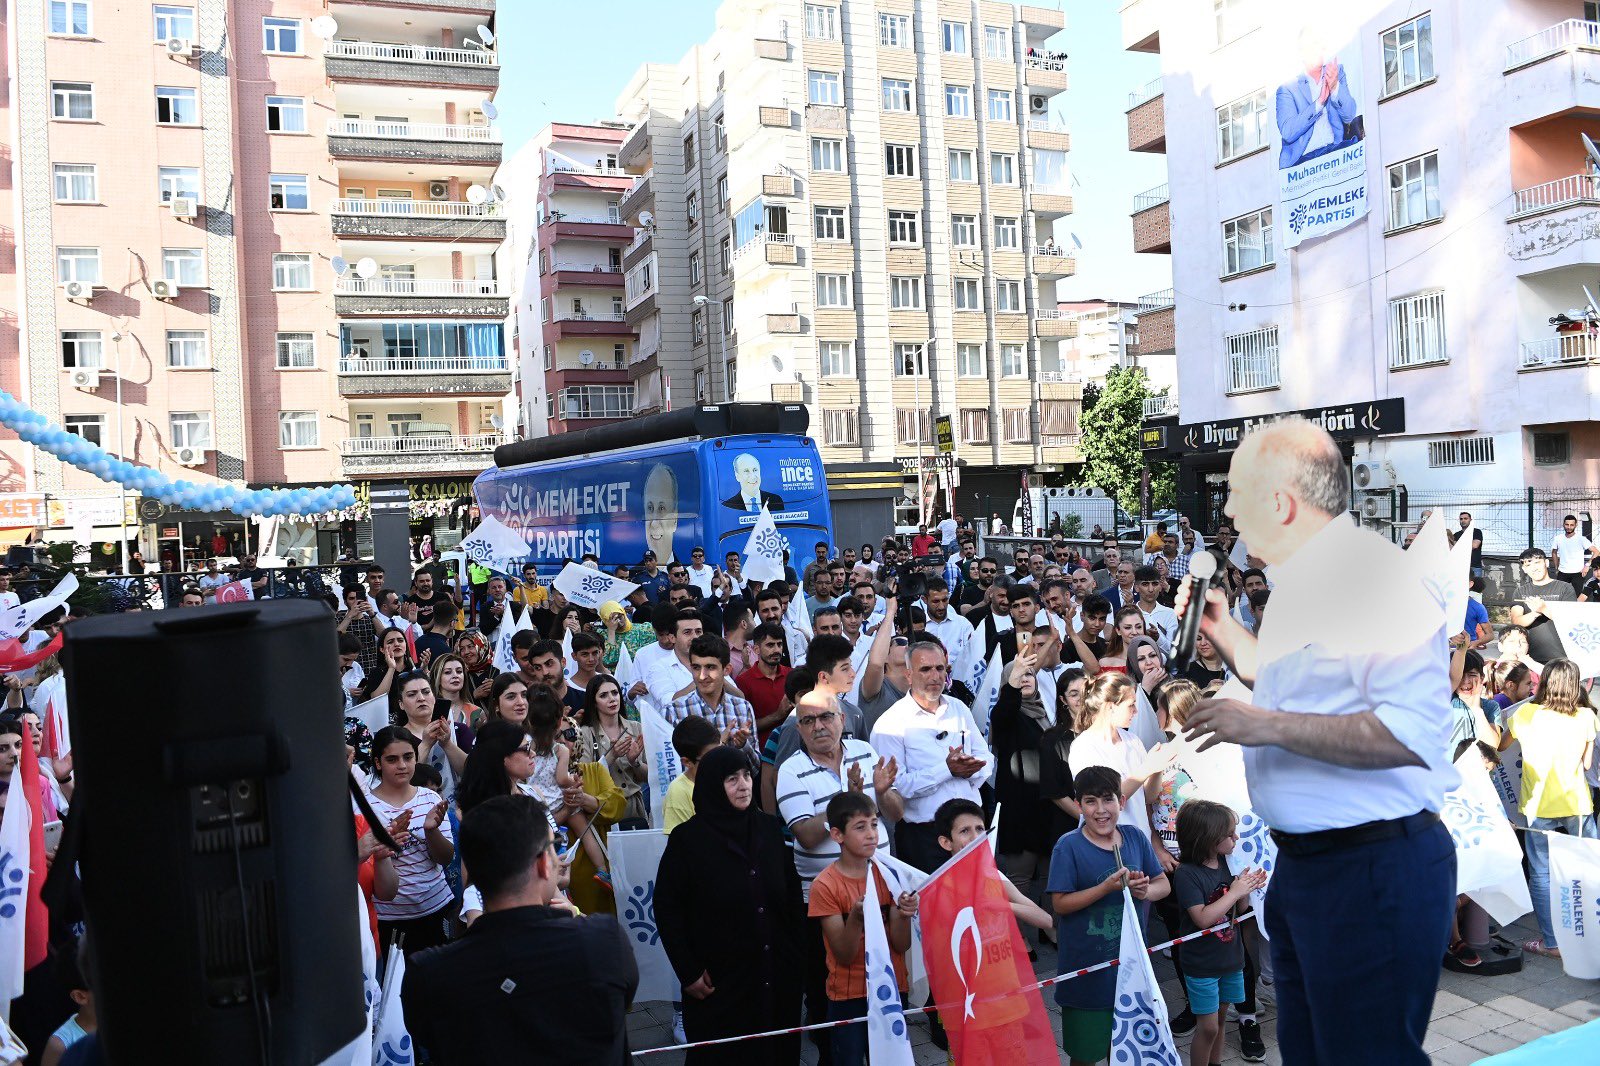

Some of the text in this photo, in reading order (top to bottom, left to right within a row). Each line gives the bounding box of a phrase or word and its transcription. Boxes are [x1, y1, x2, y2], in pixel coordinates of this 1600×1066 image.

[1287, 158, 1340, 183] Muharrem
[1308, 186, 1365, 212] MEMLEKE
[1204, 423, 1239, 447] Diyar
[779, 457, 811, 467] muharrem
[421, 480, 474, 500] SALON
[537, 482, 630, 518] MEMLEKET
[664, 742, 676, 781] MEMLE
[1496, 761, 1518, 804] EMLEKET
[1571, 879, 1585, 938] MEMLEKET
